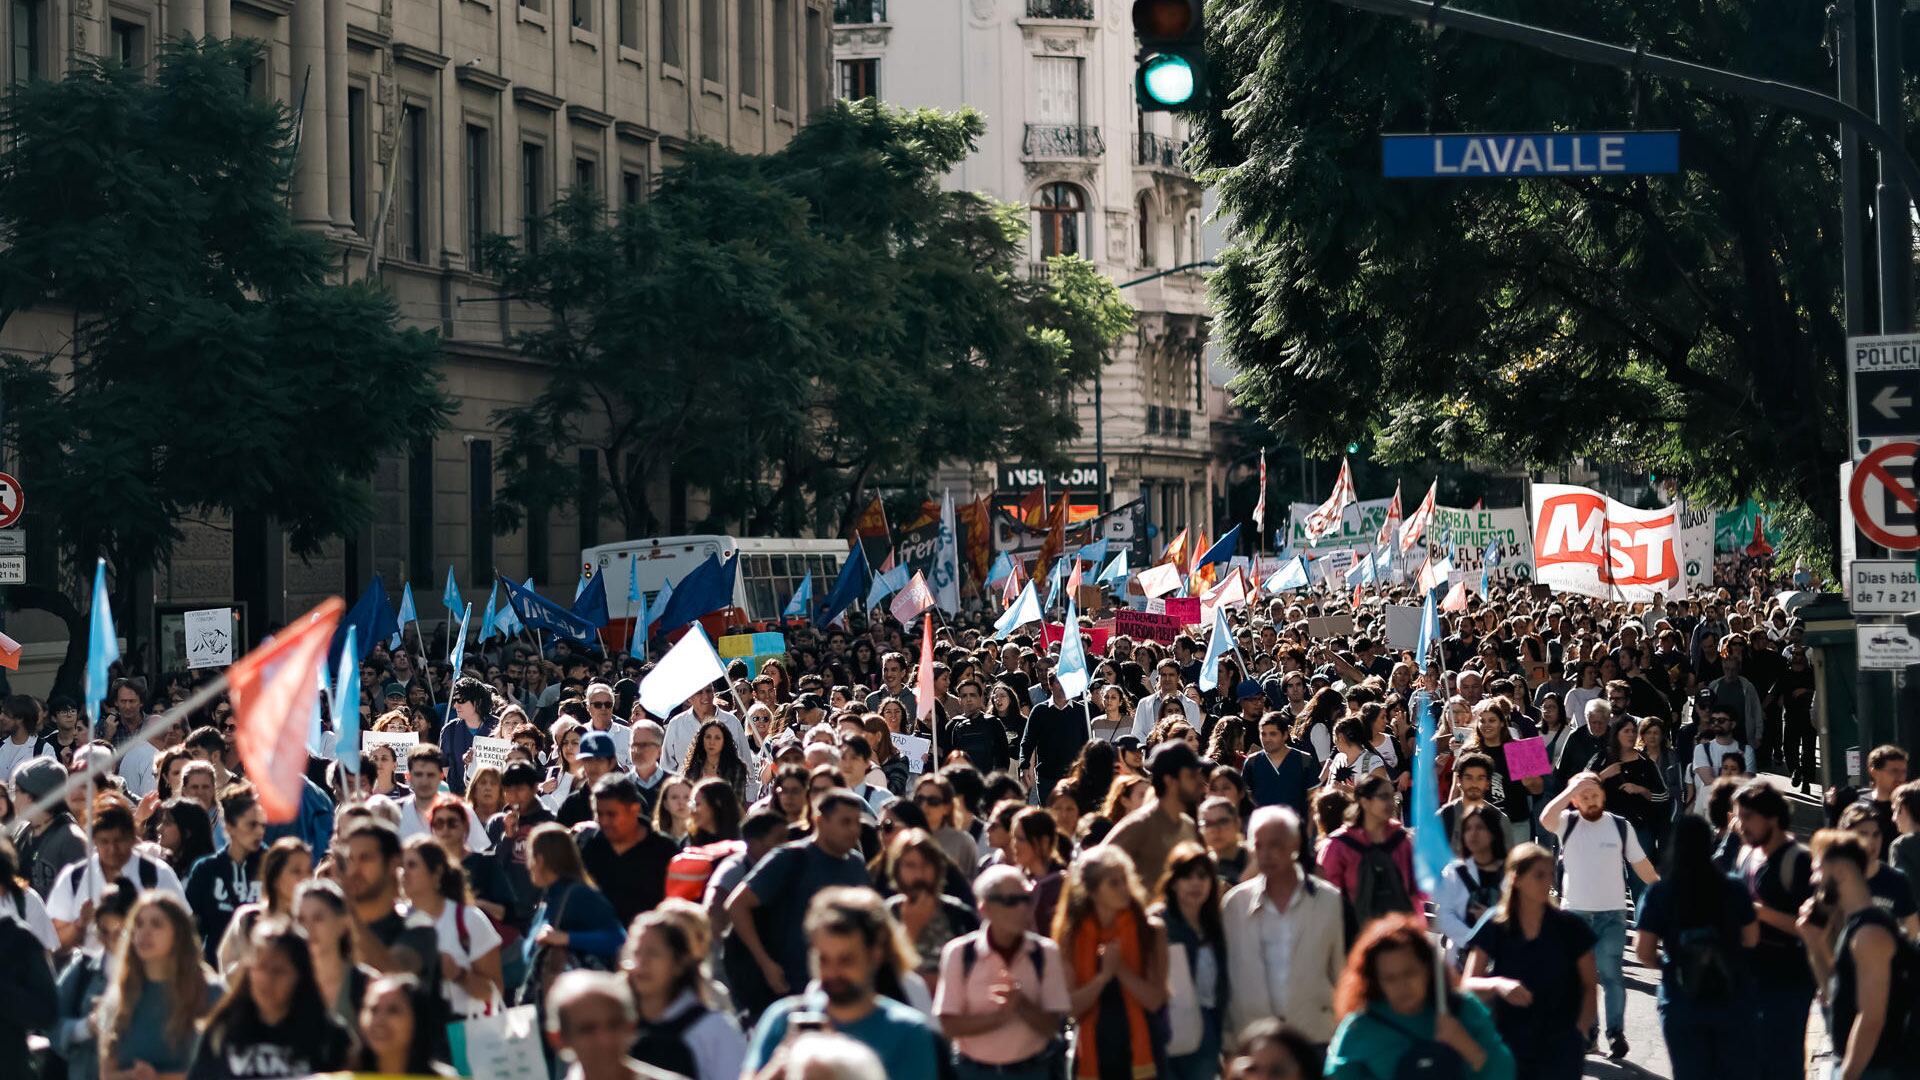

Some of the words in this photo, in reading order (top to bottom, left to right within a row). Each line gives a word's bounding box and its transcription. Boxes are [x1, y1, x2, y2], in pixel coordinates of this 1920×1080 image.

[1434, 137, 1626, 173] LAVALLE
[1856, 346, 1920, 366] POLICI
[1434, 509, 1471, 529] RRIBA
[1478, 513, 1495, 529] EL
[1428, 525, 1515, 547] PRSUPUESTO
[1542, 502, 1673, 580] MST
[898, 537, 939, 563] fren
[1459, 548, 1472, 561] EL
[1477, 545, 1506, 558] PN
[1510, 544, 1521, 556] DE
[1891, 570, 1919, 584] háb
[1857, 591, 1872, 603] de
[1876, 591, 1884, 603] 7
[1889, 593, 1897, 603] a
[1901, 590, 1916, 603] 21
[1162, 616, 1171, 625] LA
[892, 735, 906, 745] TAD
[484, 753, 507, 761] EXCELE
